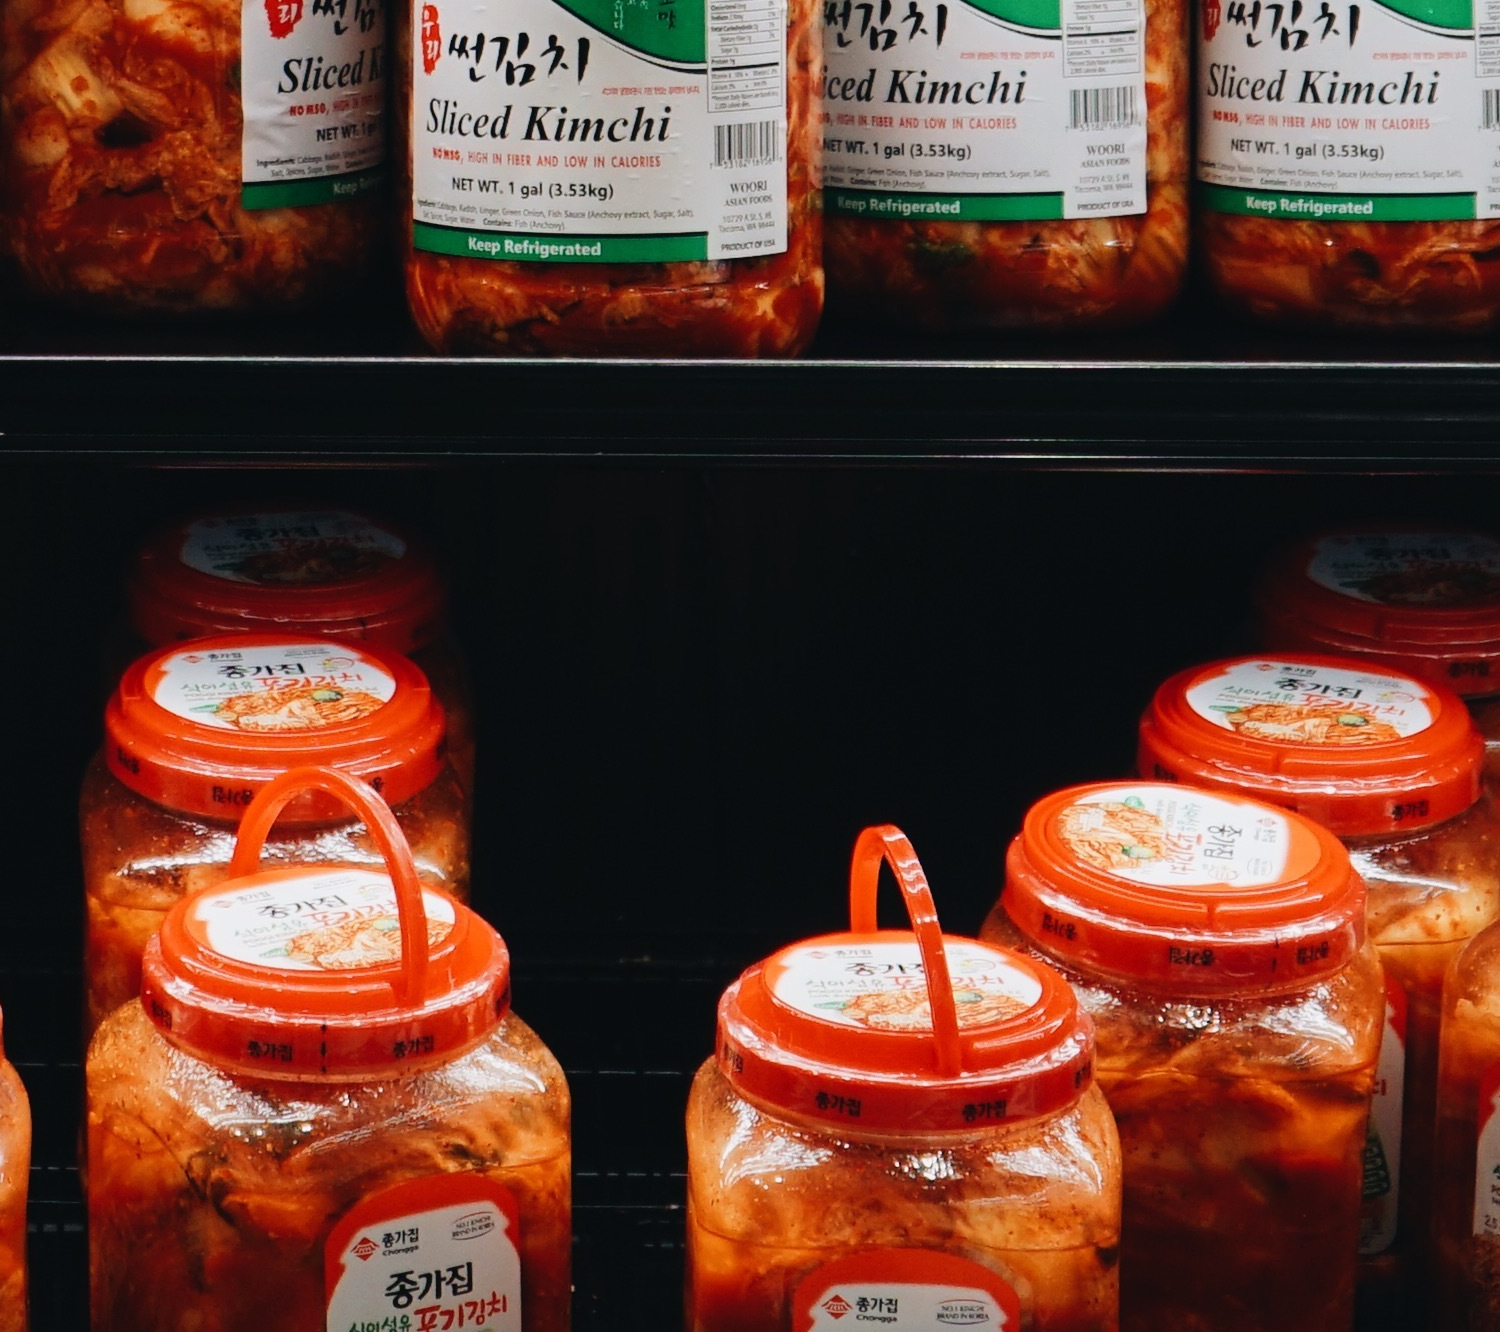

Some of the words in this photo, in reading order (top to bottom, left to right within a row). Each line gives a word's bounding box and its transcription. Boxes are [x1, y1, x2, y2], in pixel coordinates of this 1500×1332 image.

[448, 35, 589, 88] 썬김치
[426, 105, 510, 138] Sliced
[523, 105, 670, 144] Kimchi
[468, 237, 502, 257] Keep
[504, 238, 601, 259] Refrigerated
[384, 1261, 474, 1308] 종가집
[854, 1297, 899, 1315] 종가집
